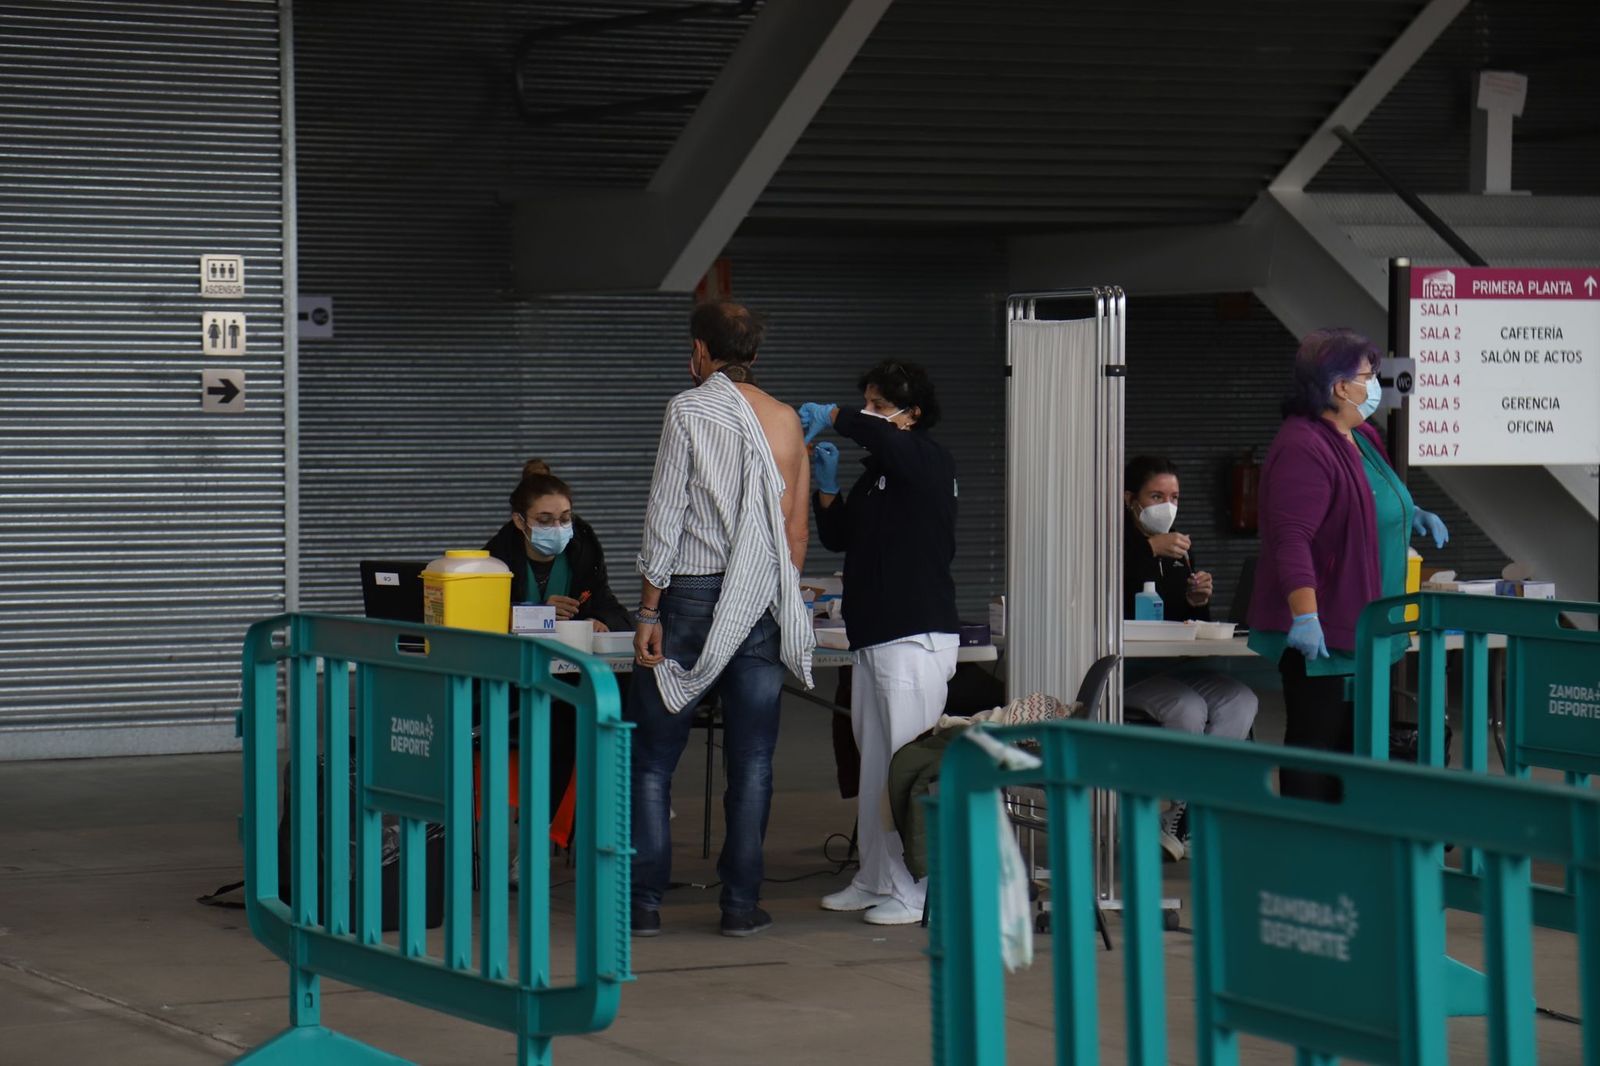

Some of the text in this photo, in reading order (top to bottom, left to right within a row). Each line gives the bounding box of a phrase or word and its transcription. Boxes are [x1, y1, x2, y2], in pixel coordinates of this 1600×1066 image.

[204, 285, 241, 294] ASCENSOR
[1472, 280, 1573, 295] PRIMERA PLANTA
[1420, 303, 1450, 316] SALA
[1420, 326, 1461, 340] SALA 2
[1500, 325, 1563, 340] CAFETERÍA
[1420, 350, 1461, 363] SALA 3
[1481, 348, 1583, 364] SALÓN DE ACTOS
[1419, 374, 1460, 387] SALA 4
[1419, 397, 1460, 410] SALA 5
[1501, 396, 1560, 410] GERENCIA
[1419, 420, 1460, 434] SALA 6
[1507, 420, 1554, 434] OFICINA
[1418, 444, 1459, 457] SALA 7
[543, 619, 554, 629] M
[1549, 684, 1595, 701] ZAMORA
[1549, 700, 1600, 719] DEPORTE
[391, 717, 425, 737] ZAMORA
[391, 735, 430, 758] DEPORTE
[1260, 891, 1334, 927] ZAMORA
[1261, 918, 1351, 962] DEPORTE
